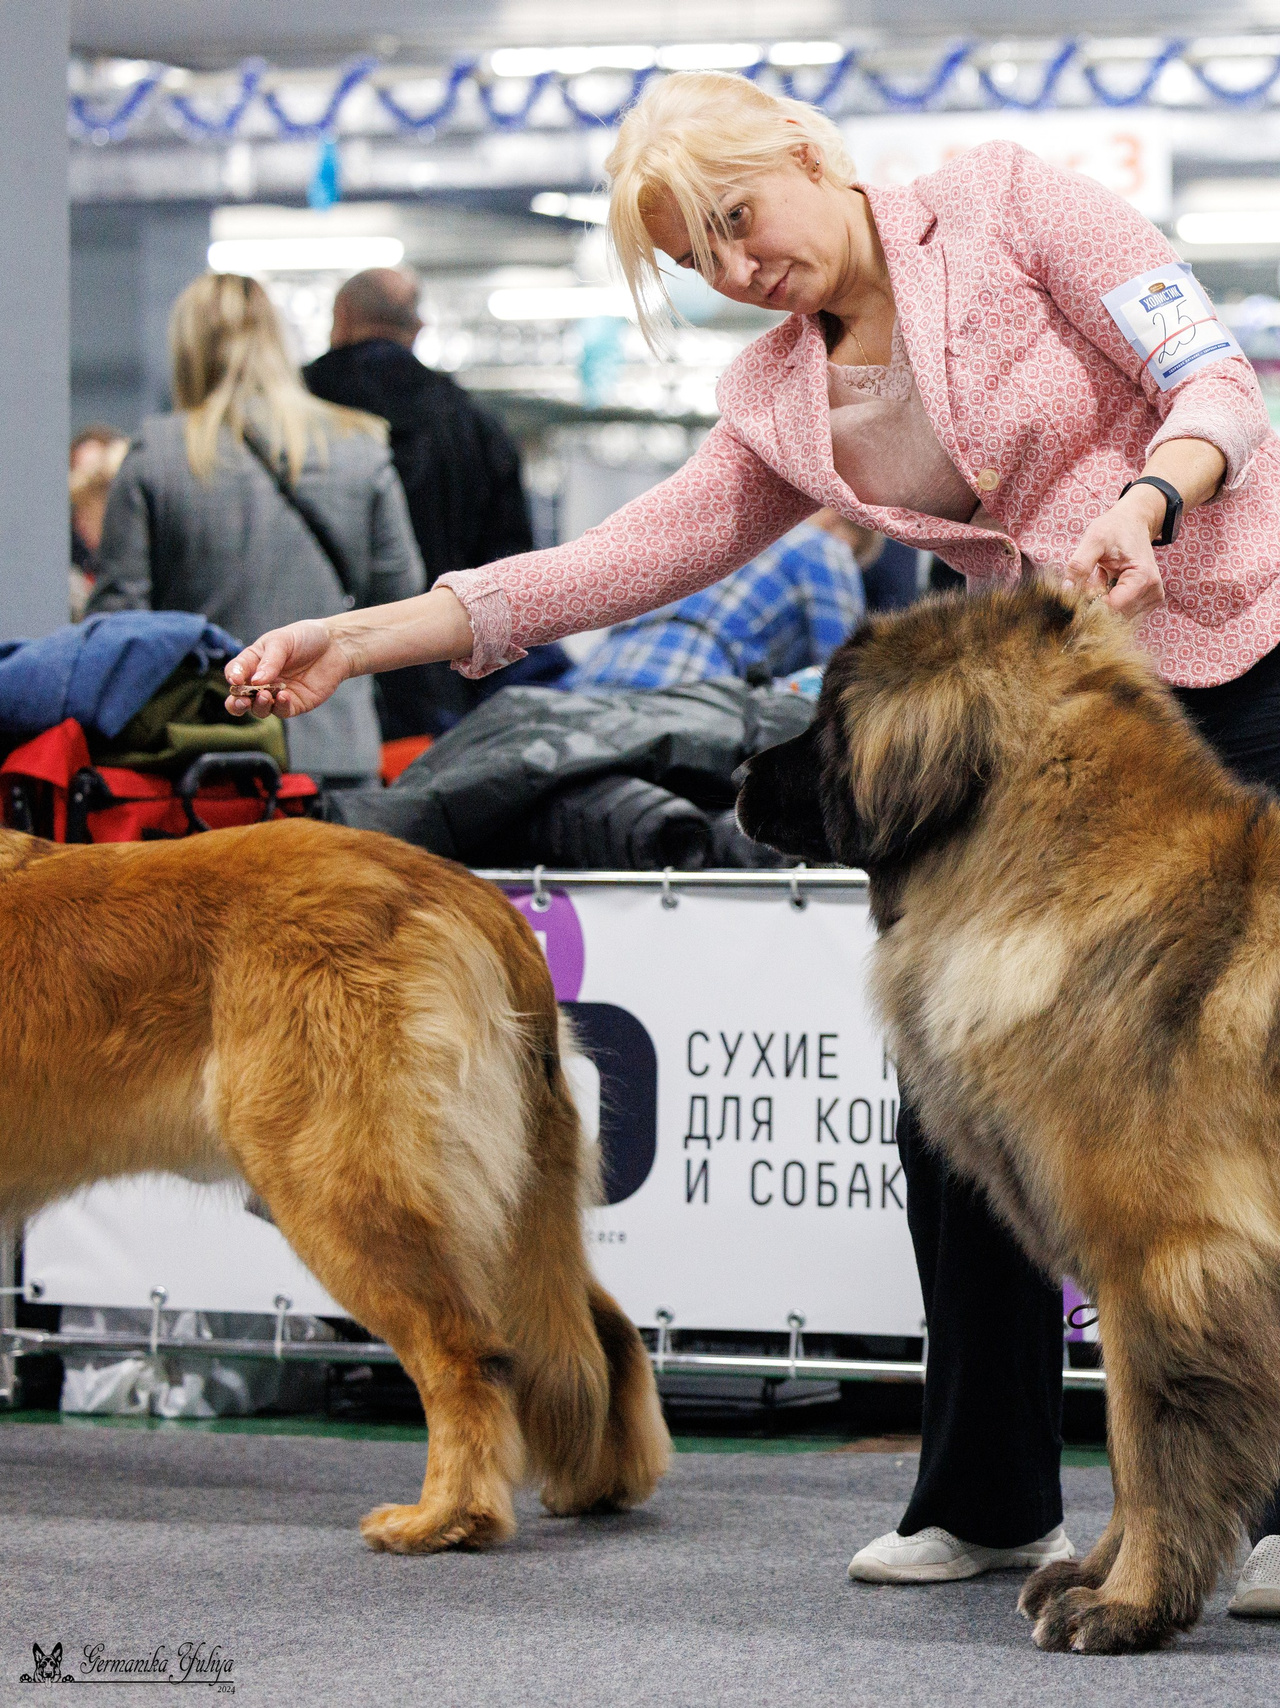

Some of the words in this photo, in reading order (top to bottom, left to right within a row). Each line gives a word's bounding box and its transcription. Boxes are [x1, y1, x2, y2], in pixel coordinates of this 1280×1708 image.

[1142, 286, 1183, 310] ХОЛИСТИК
[1152, 299, 1197, 364] 25
[687, 1031, 838, 1078] СУХИЕ
[684, 1095, 773, 1150] ДЛЯ
[686, 1158, 709, 1204] И
[750, 1160, 905, 1210] СОБАК
